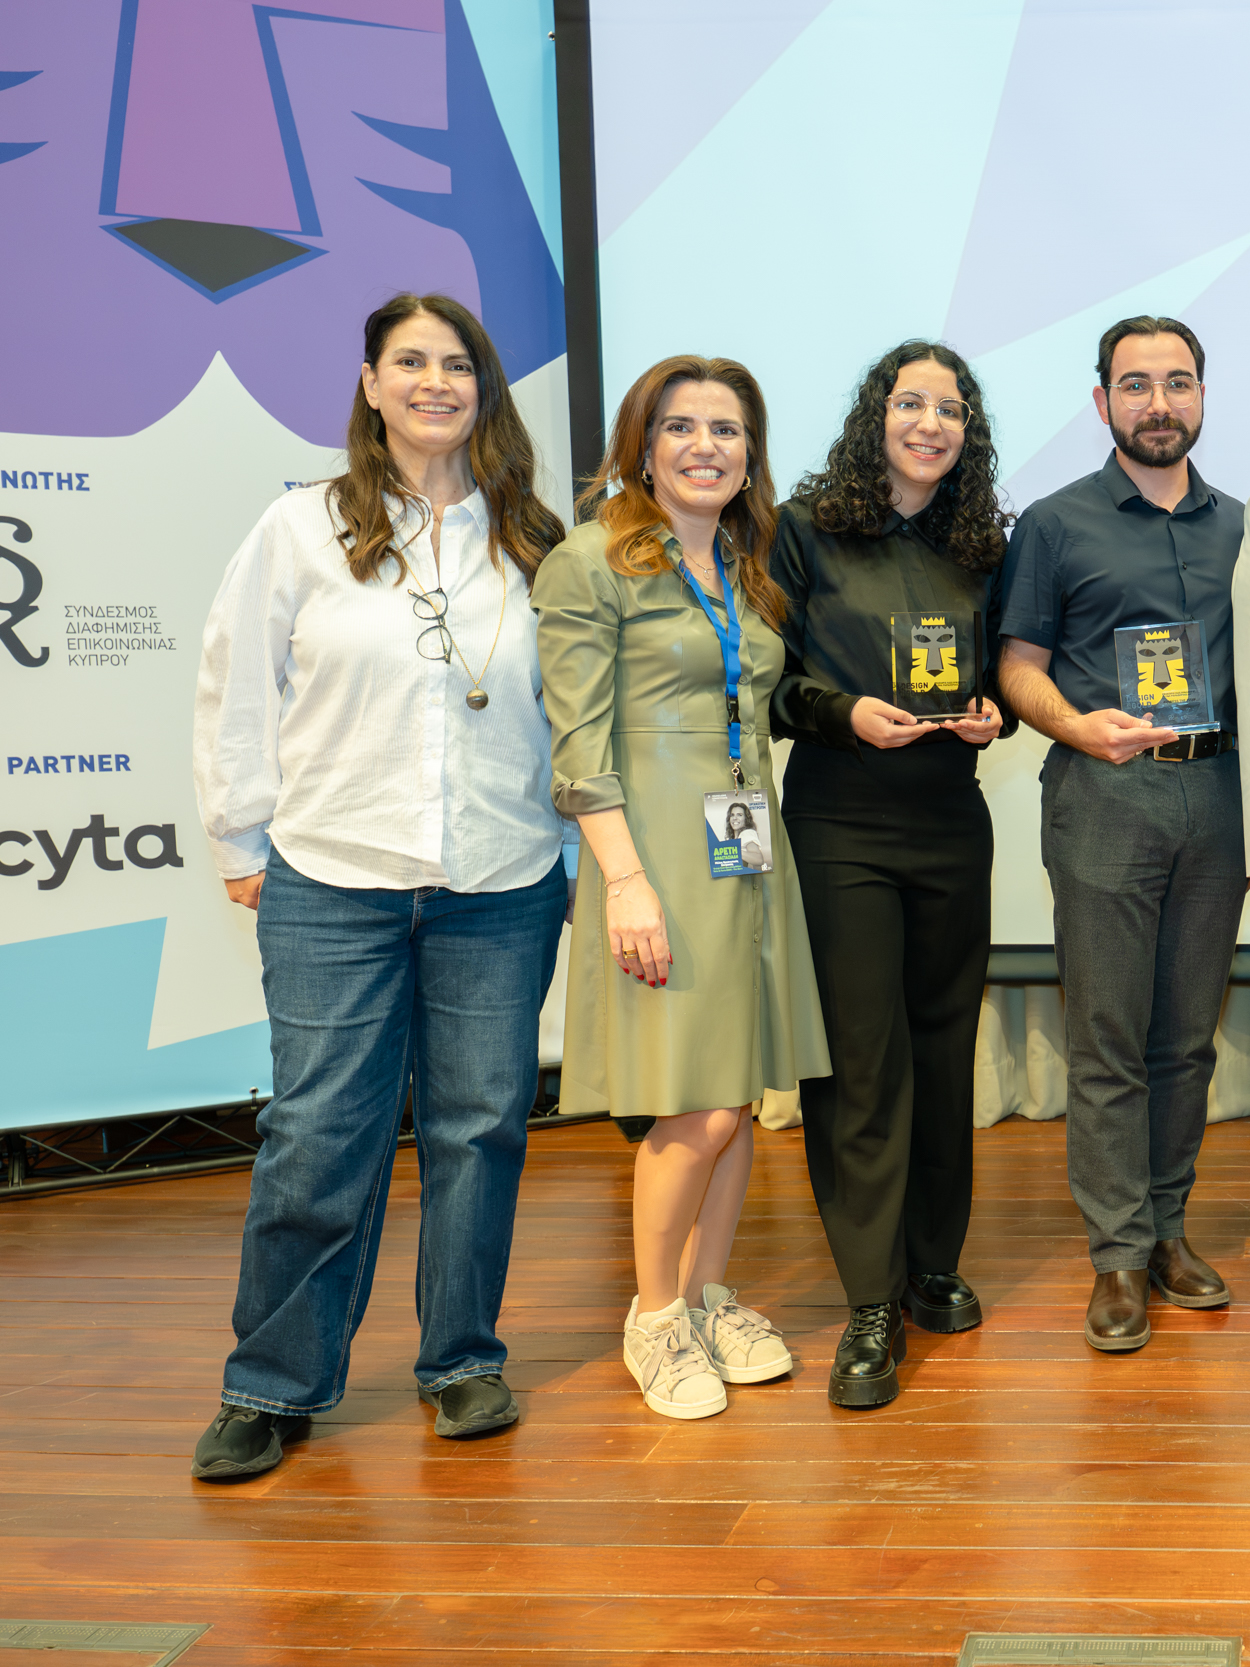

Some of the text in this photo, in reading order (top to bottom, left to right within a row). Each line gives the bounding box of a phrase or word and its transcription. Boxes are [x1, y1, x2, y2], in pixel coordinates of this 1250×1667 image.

[64, 605, 158, 618] ΣΥΝΔΕΣΜΟΣ
[66, 621, 162, 635] ΔΙΑΦΗΜΙΣΗΣ
[67, 637, 177, 651] ΕΠΙΚΟΙΝΩΝΙΑΣ
[68, 653, 129, 667] ΚΥΠΡΟΥ
[901, 682, 928, 690] DESIGN
[1126, 694, 1155, 702] DESIGN
[7, 754, 132, 775] PARTNER
[0, 814, 184, 891] cyta
